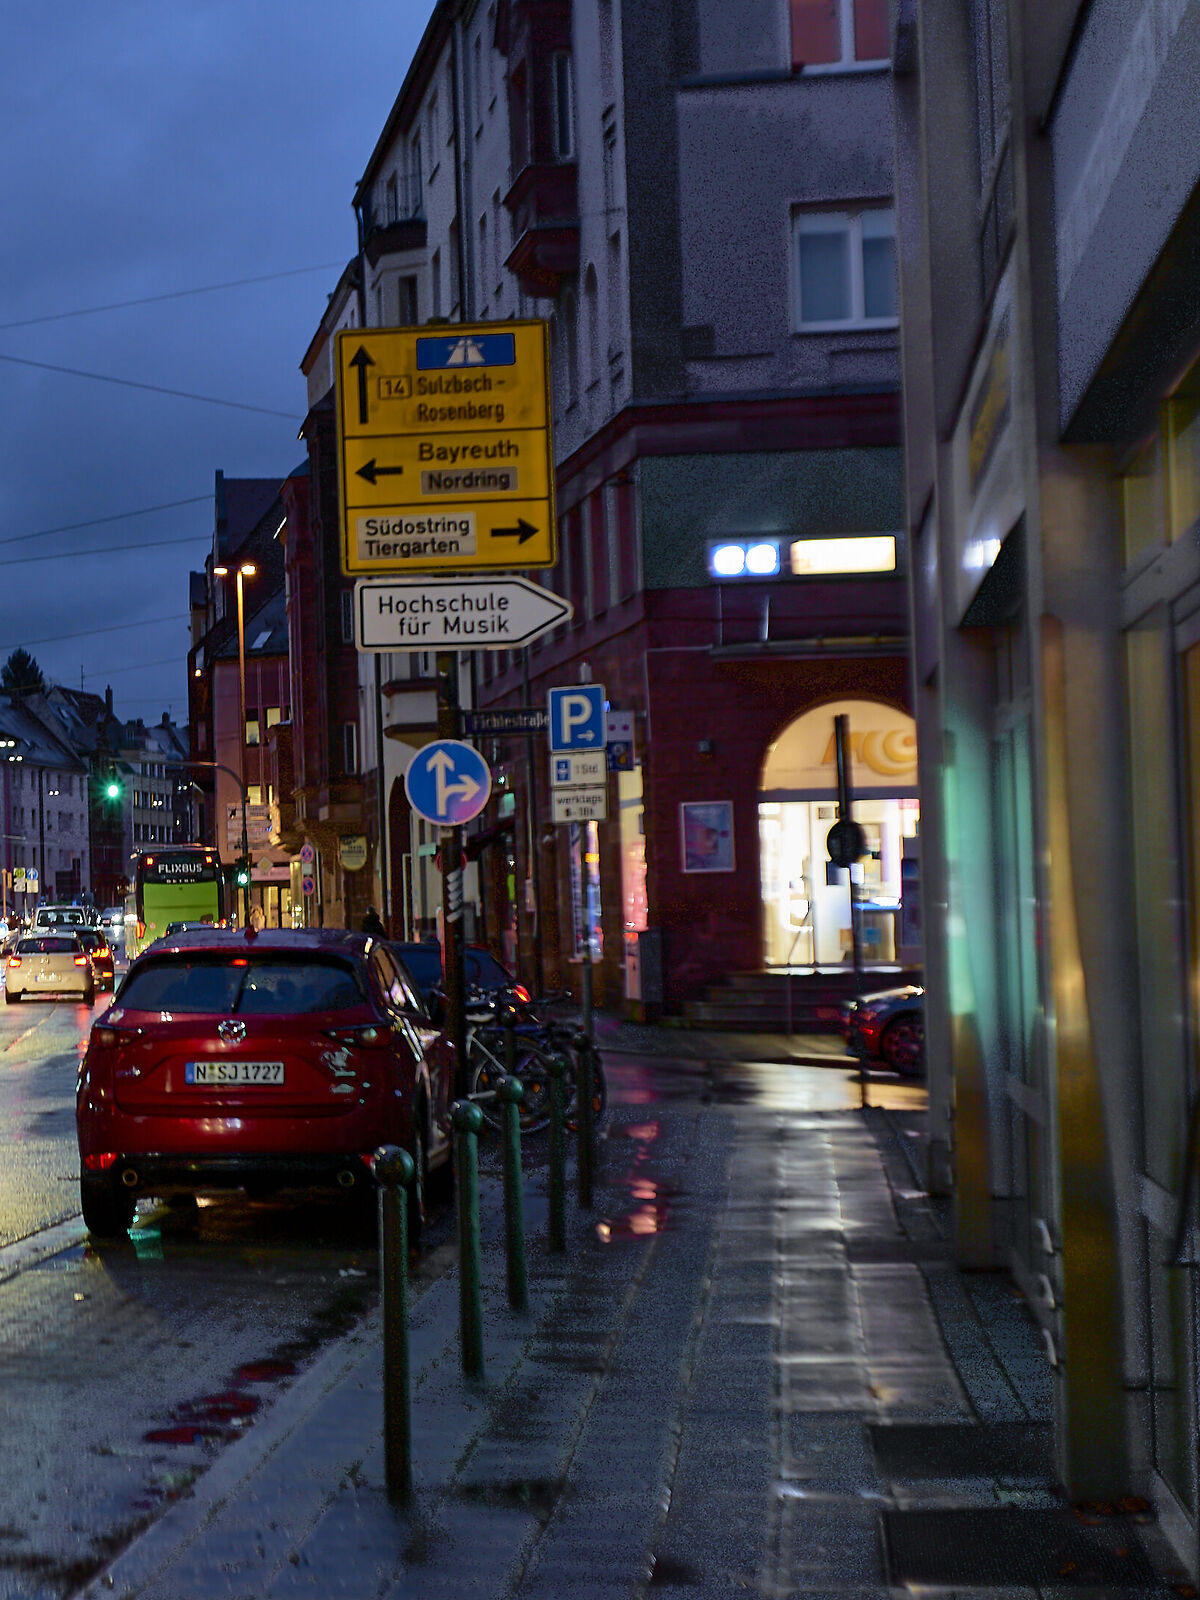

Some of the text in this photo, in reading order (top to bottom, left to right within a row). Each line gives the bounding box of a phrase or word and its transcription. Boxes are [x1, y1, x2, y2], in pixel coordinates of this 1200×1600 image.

[384, 379, 405, 396] 14
[417, 401, 505, 422] Rosenberg
[418, 440, 519, 464] Bayreuth
[428, 470, 511, 491] Nordring
[365, 518, 470, 538] Südostring
[365, 538, 460, 558] Tiergarten
[379, 593, 509, 614] Hochschule
[399, 615, 510, 636] für Musik
[561, 695, 592, 743] P
[158, 864, 203, 874] FLIXBUS
[196, 1065, 281, 1080] N SJ 1727
